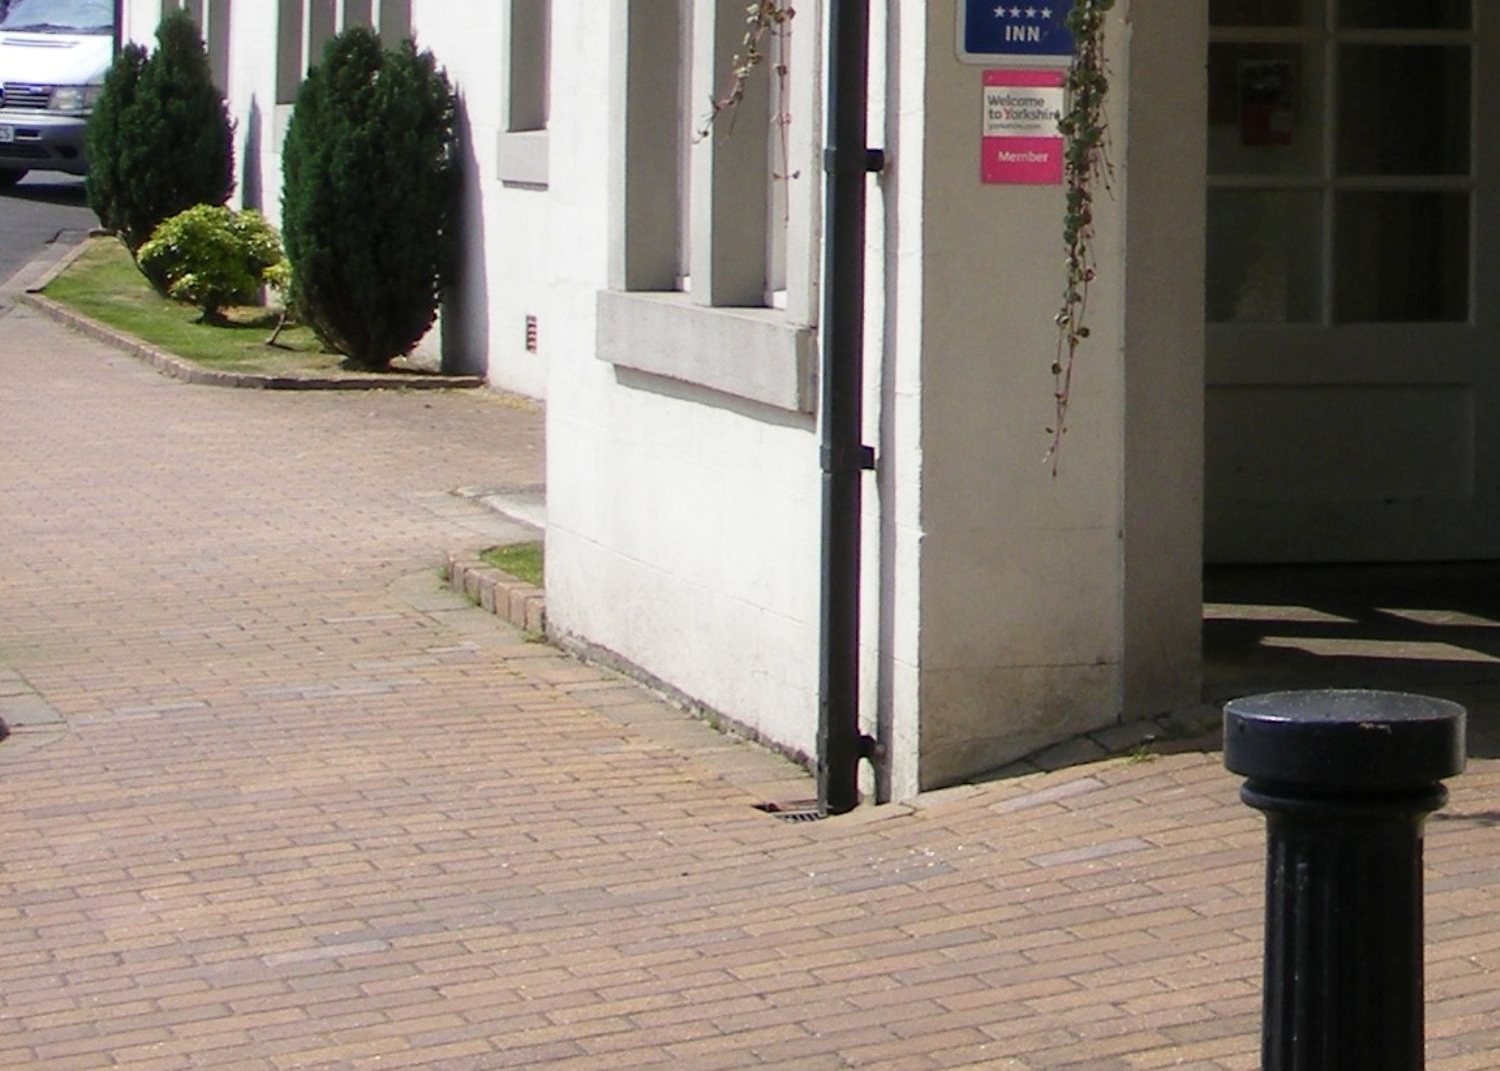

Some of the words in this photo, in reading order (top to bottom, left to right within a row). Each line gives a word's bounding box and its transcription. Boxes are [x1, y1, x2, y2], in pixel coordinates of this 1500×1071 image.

[1005, 25, 1041, 42] INN
[987, 94, 1045, 107] Welcome
[988, 108, 1002, 120] to
[997, 150, 1049, 163] Member
